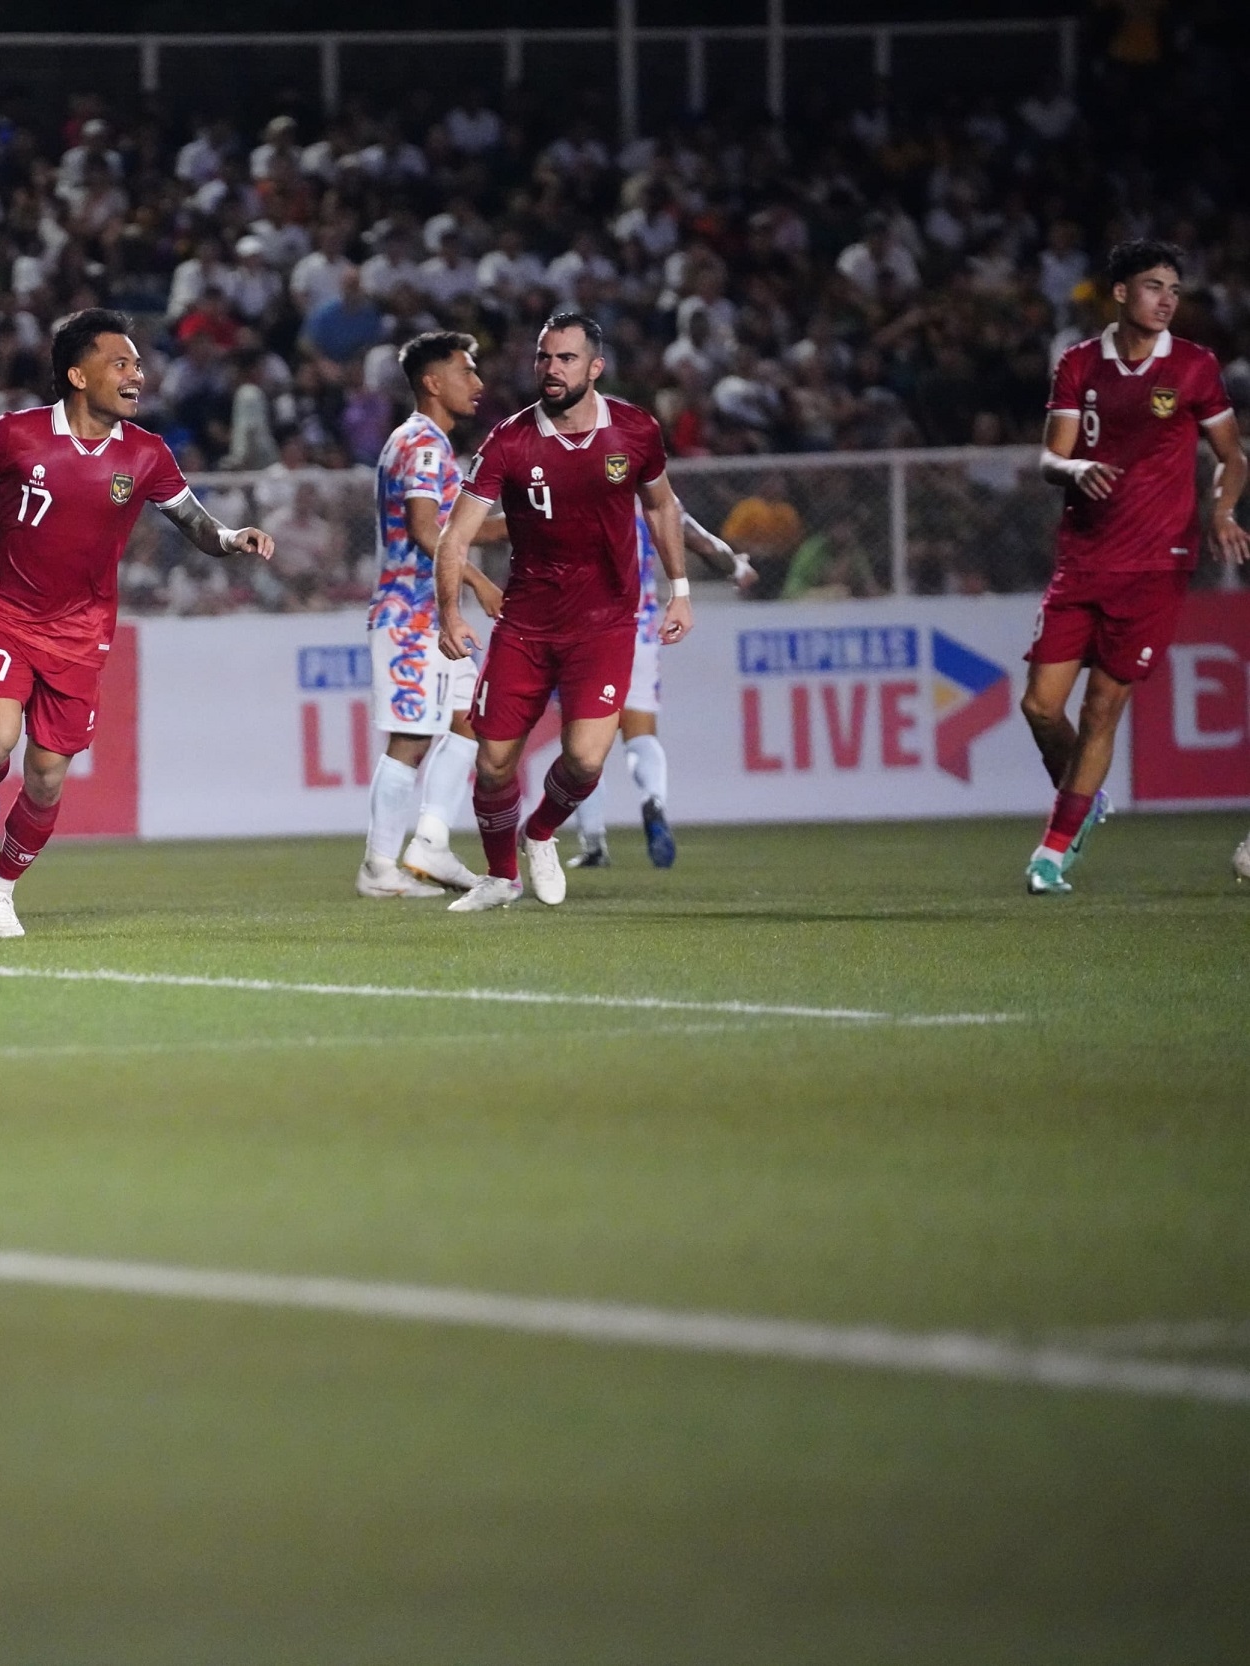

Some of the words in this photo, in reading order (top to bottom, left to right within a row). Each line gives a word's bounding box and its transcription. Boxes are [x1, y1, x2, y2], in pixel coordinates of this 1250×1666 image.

[1083, 410, 1101, 447] 9
[17, 484, 53, 527] 17
[527, 486, 553, 519] 4
[742, 679, 921, 772] LIVE
